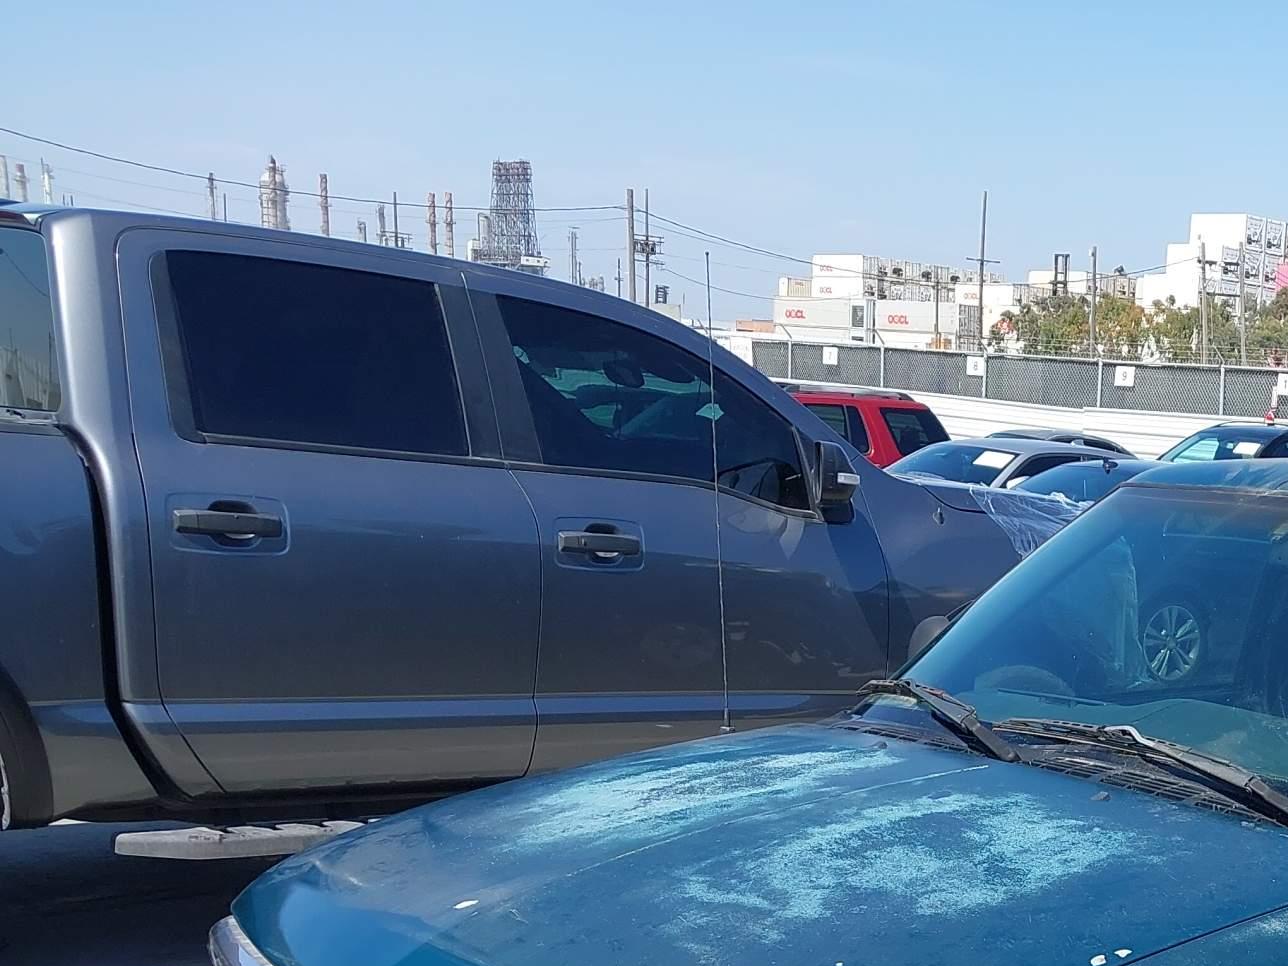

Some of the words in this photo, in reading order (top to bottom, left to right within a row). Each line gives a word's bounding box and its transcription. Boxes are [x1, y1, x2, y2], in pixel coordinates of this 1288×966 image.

[887, 314, 910, 325] OOCL
[973, 360, 979, 371] 8
[1122, 370, 1128, 381] 9
